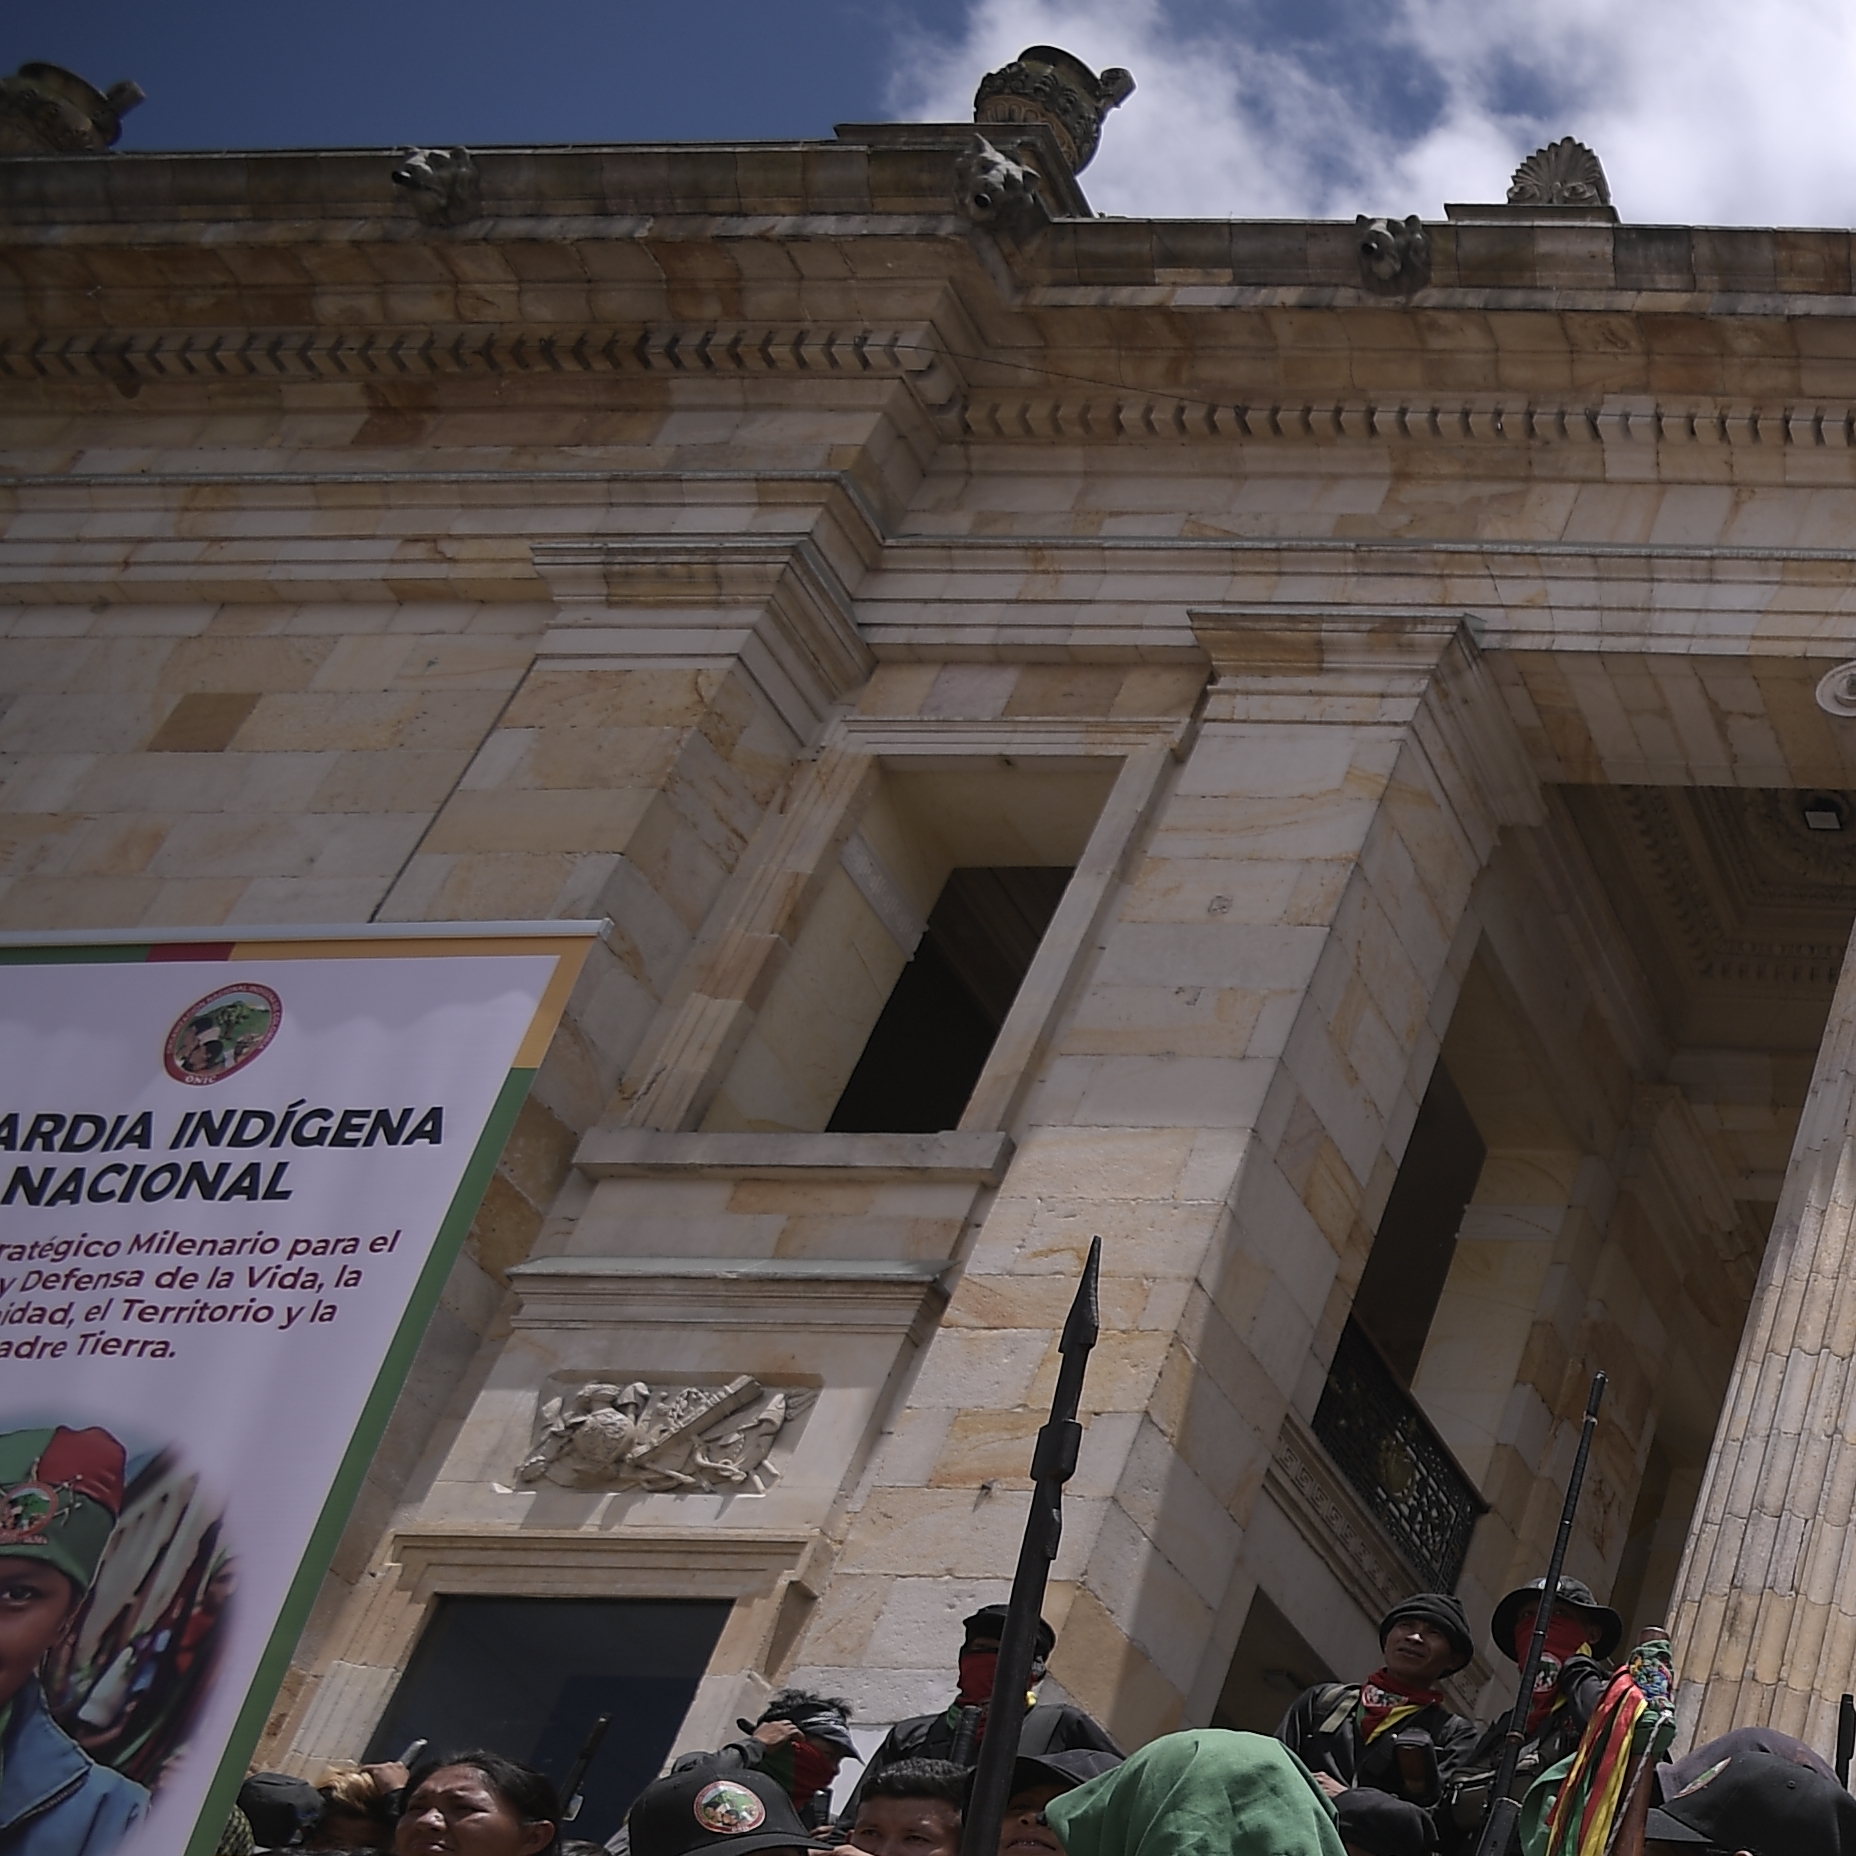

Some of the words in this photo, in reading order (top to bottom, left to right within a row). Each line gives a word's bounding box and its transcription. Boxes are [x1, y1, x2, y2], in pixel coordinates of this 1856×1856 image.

[185, 1074, 218, 1085] ONIC
[0, 1111, 154, 1152] ARDIA
[168, 1098, 444, 1151] INDÍGENA
[1, 1161, 294, 1207] NACIONAL
[0, 1232, 122, 1263] ratégico
[127, 1229, 281, 1257] Milenario
[286, 1235, 361, 1261] para
[368, 1229, 402, 1253] el
[0, 1276, 17, 1299] y
[20, 1267, 146, 1293] Defensa
[155, 1265, 200, 1290] de
[206, 1266, 235, 1290] la
[248, 1264, 325, 1294] Vida,
[333, 1265, 362, 1288] la
[0, 1301, 76, 1329] idad,
[84, 1297, 115, 1323] el
[121, 1298, 275, 1325] Territorio
[277, 1305, 305, 1330] y
[309, 1299, 338, 1323] la
[0, 1335, 68, 1360] adre
[77, 1330, 177, 1359] Tierra.
